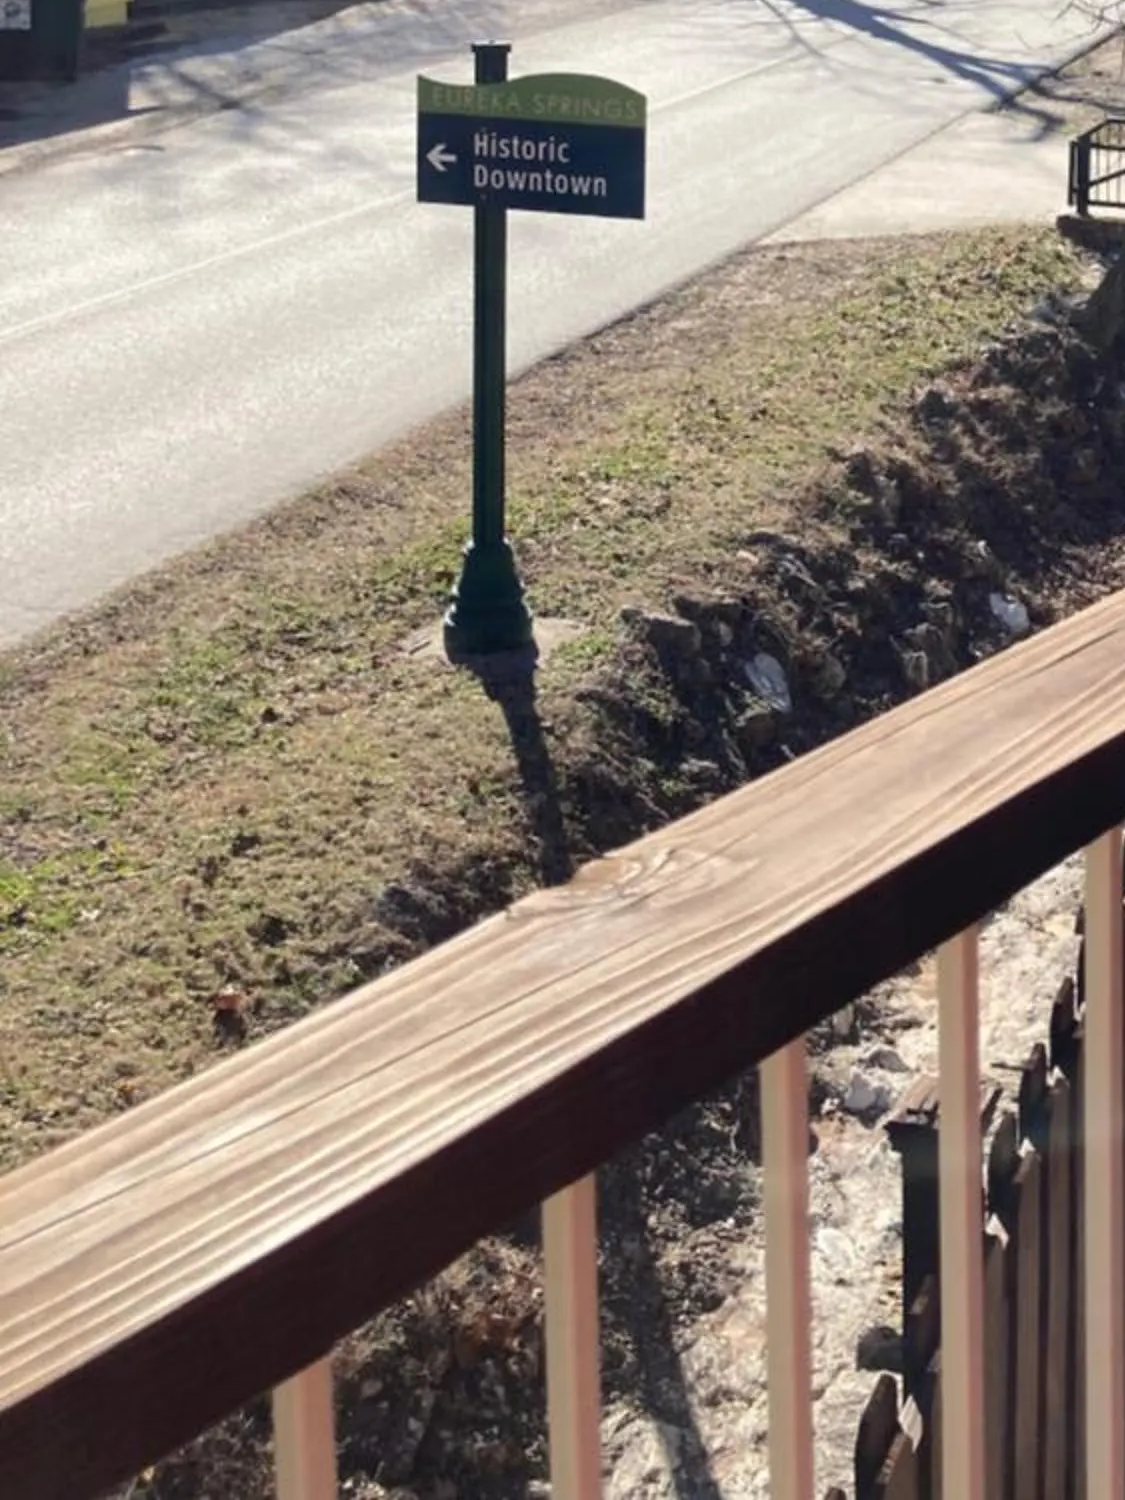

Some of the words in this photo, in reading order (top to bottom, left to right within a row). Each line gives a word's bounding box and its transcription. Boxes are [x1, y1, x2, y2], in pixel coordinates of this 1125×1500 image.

[432, 86, 521, 113] EUREKA
[532, 95, 637, 119] SPRINGS
[474, 132, 570, 163] Historic
[474, 164, 607, 197] Downtown
